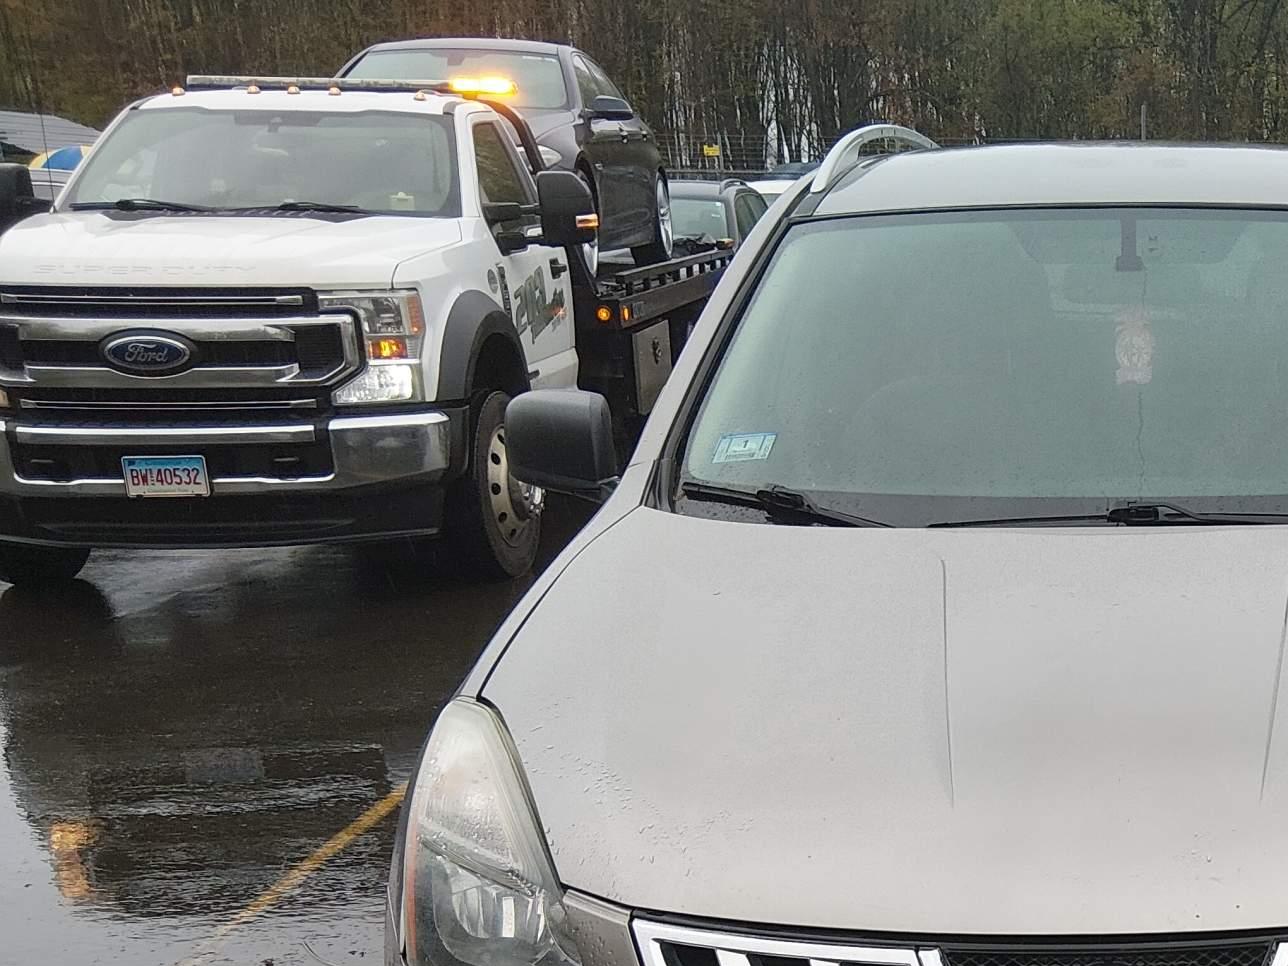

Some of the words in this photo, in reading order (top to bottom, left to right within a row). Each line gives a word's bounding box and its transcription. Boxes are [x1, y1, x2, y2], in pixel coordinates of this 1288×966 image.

[33, 264, 152, 275] SUPER
[161, 265, 257, 276] DUTY
[124, 342, 169, 362] Ford
